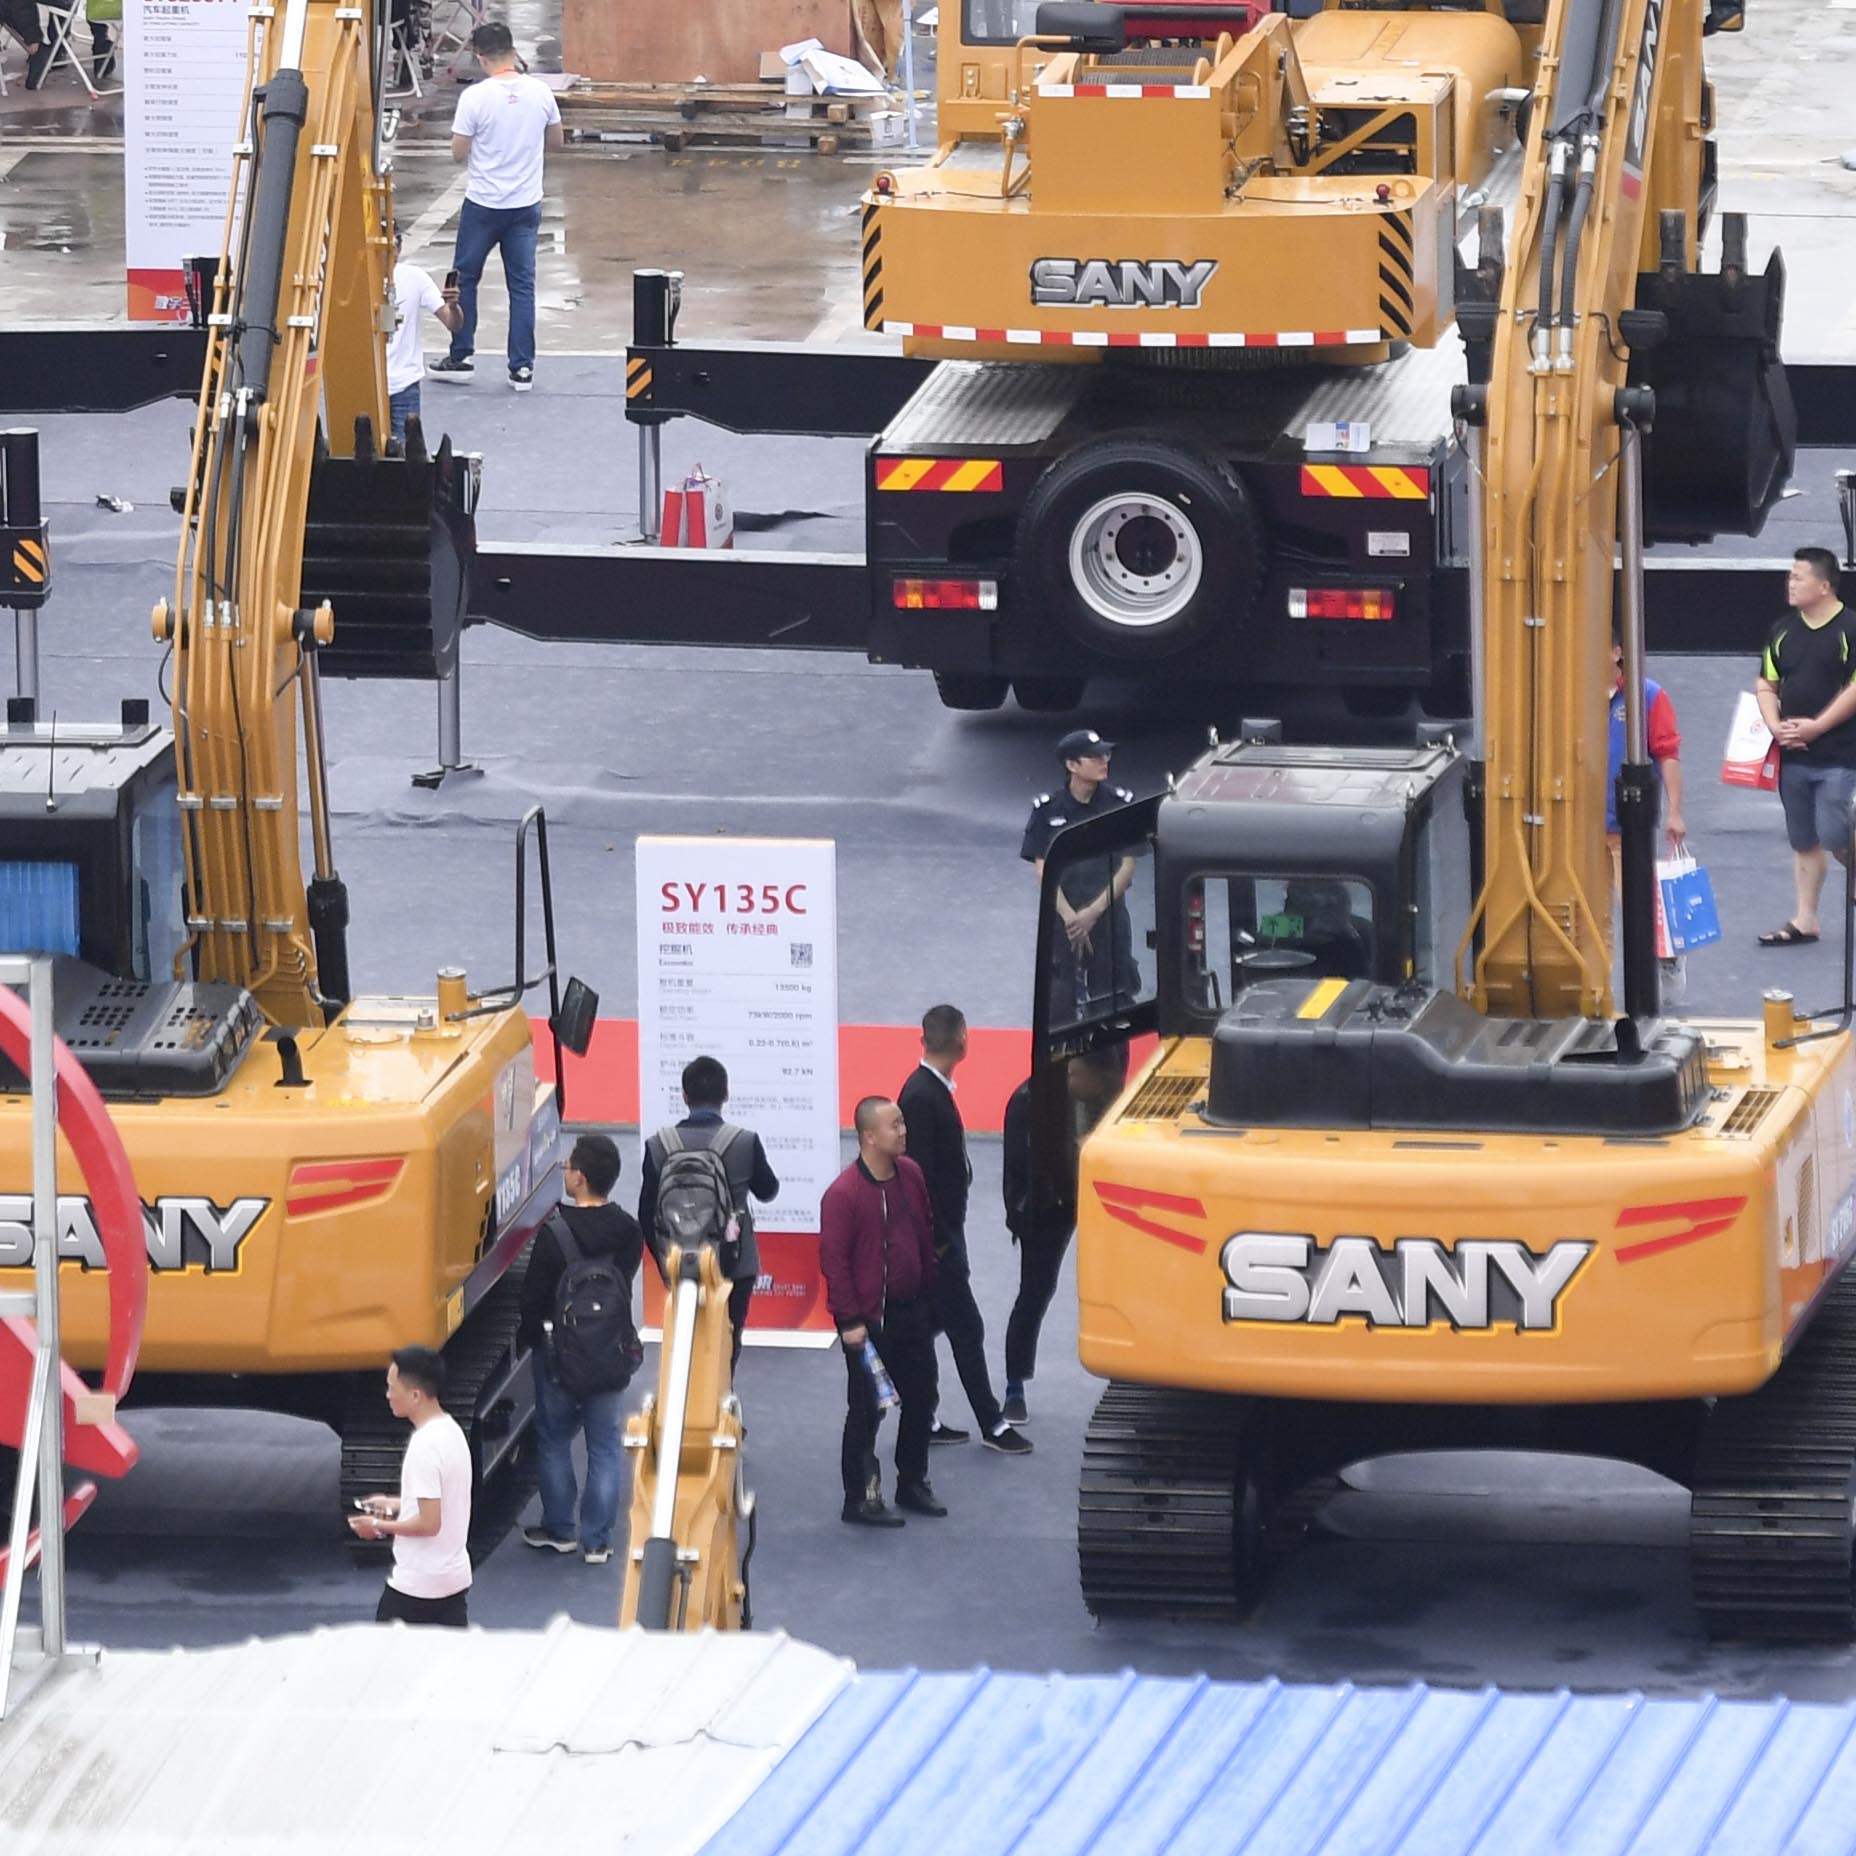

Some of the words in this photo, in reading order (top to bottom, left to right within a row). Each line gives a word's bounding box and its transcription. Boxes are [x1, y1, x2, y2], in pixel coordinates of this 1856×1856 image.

[1029, 258, 1219, 308] SANY
[661, 882, 807, 914] SY135C
[662, 922, 715, 935] 极致能效
[726, 923, 779, 936] 传承经典
[1222, 1232, 1597, 1335] SANY
